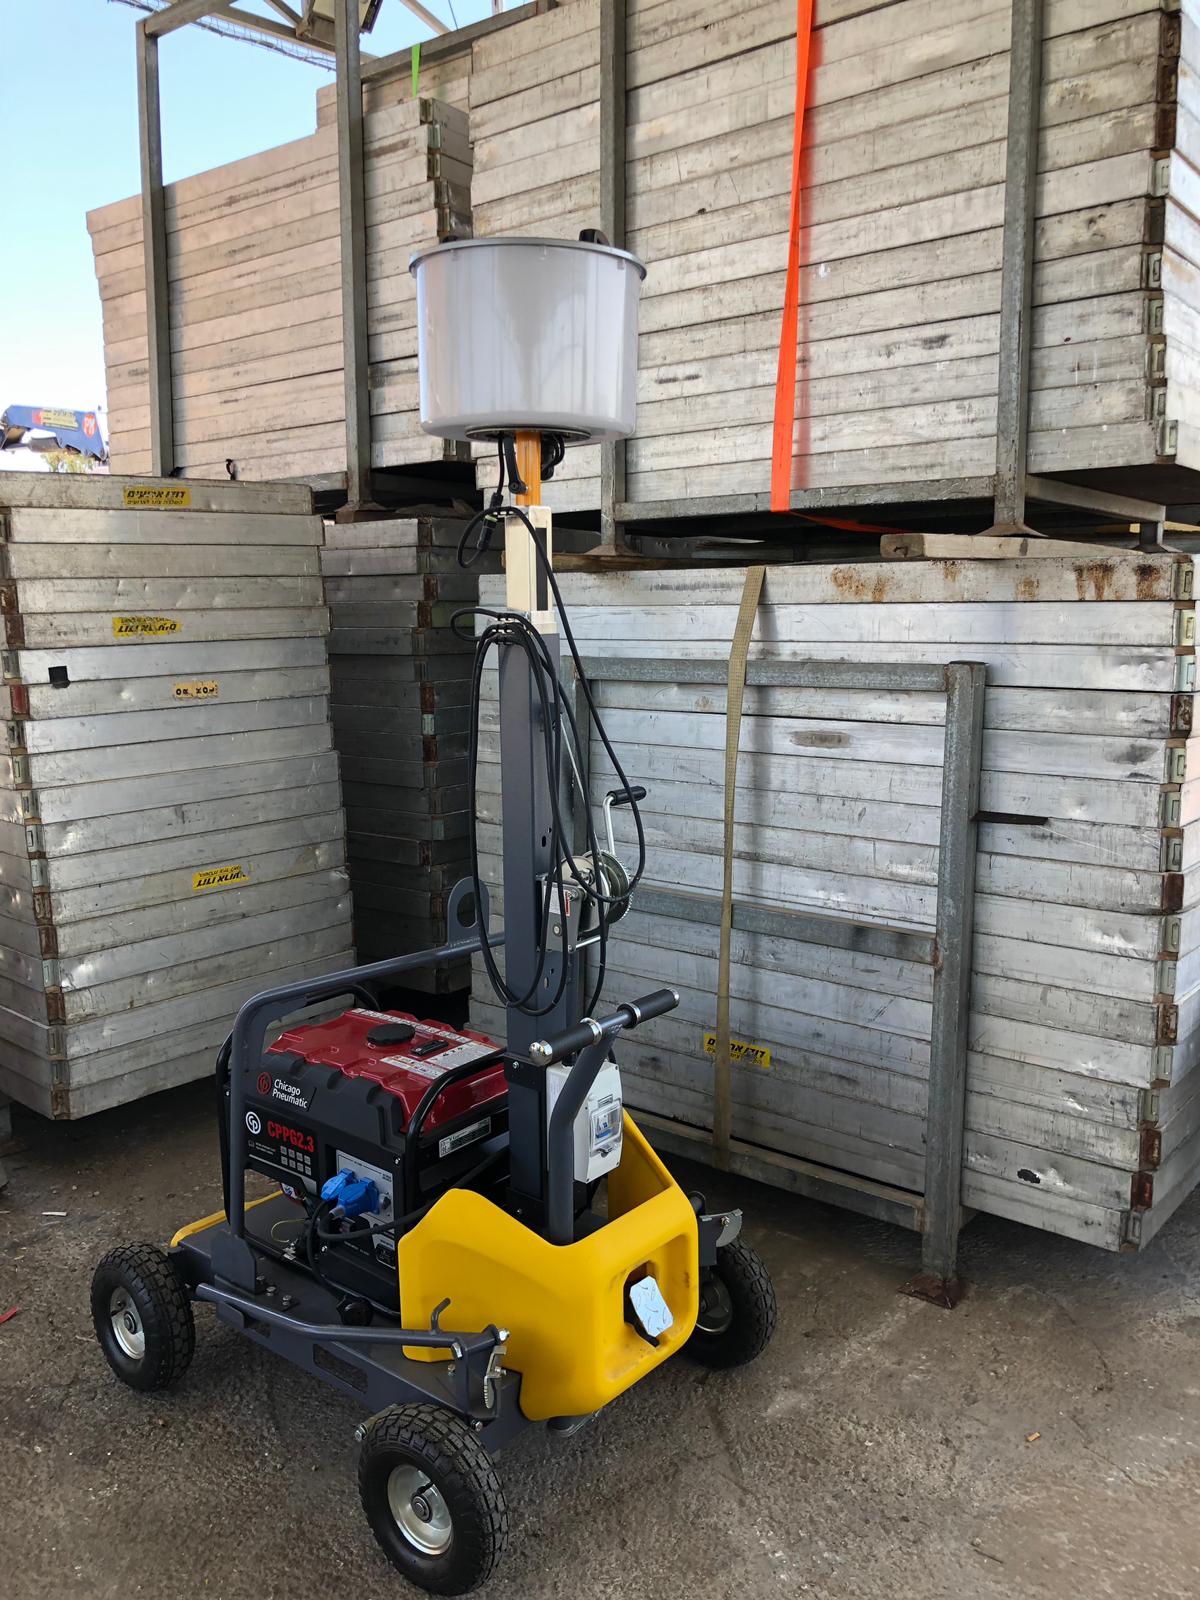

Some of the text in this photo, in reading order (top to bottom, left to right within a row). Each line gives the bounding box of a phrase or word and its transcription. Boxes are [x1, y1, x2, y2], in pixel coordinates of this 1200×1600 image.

[274, 1079, 301, 1096] Chicago
[272, 1088, 308, 1109] Pneumatic
[267, 1120, 315, 1153] CPPG2.3
